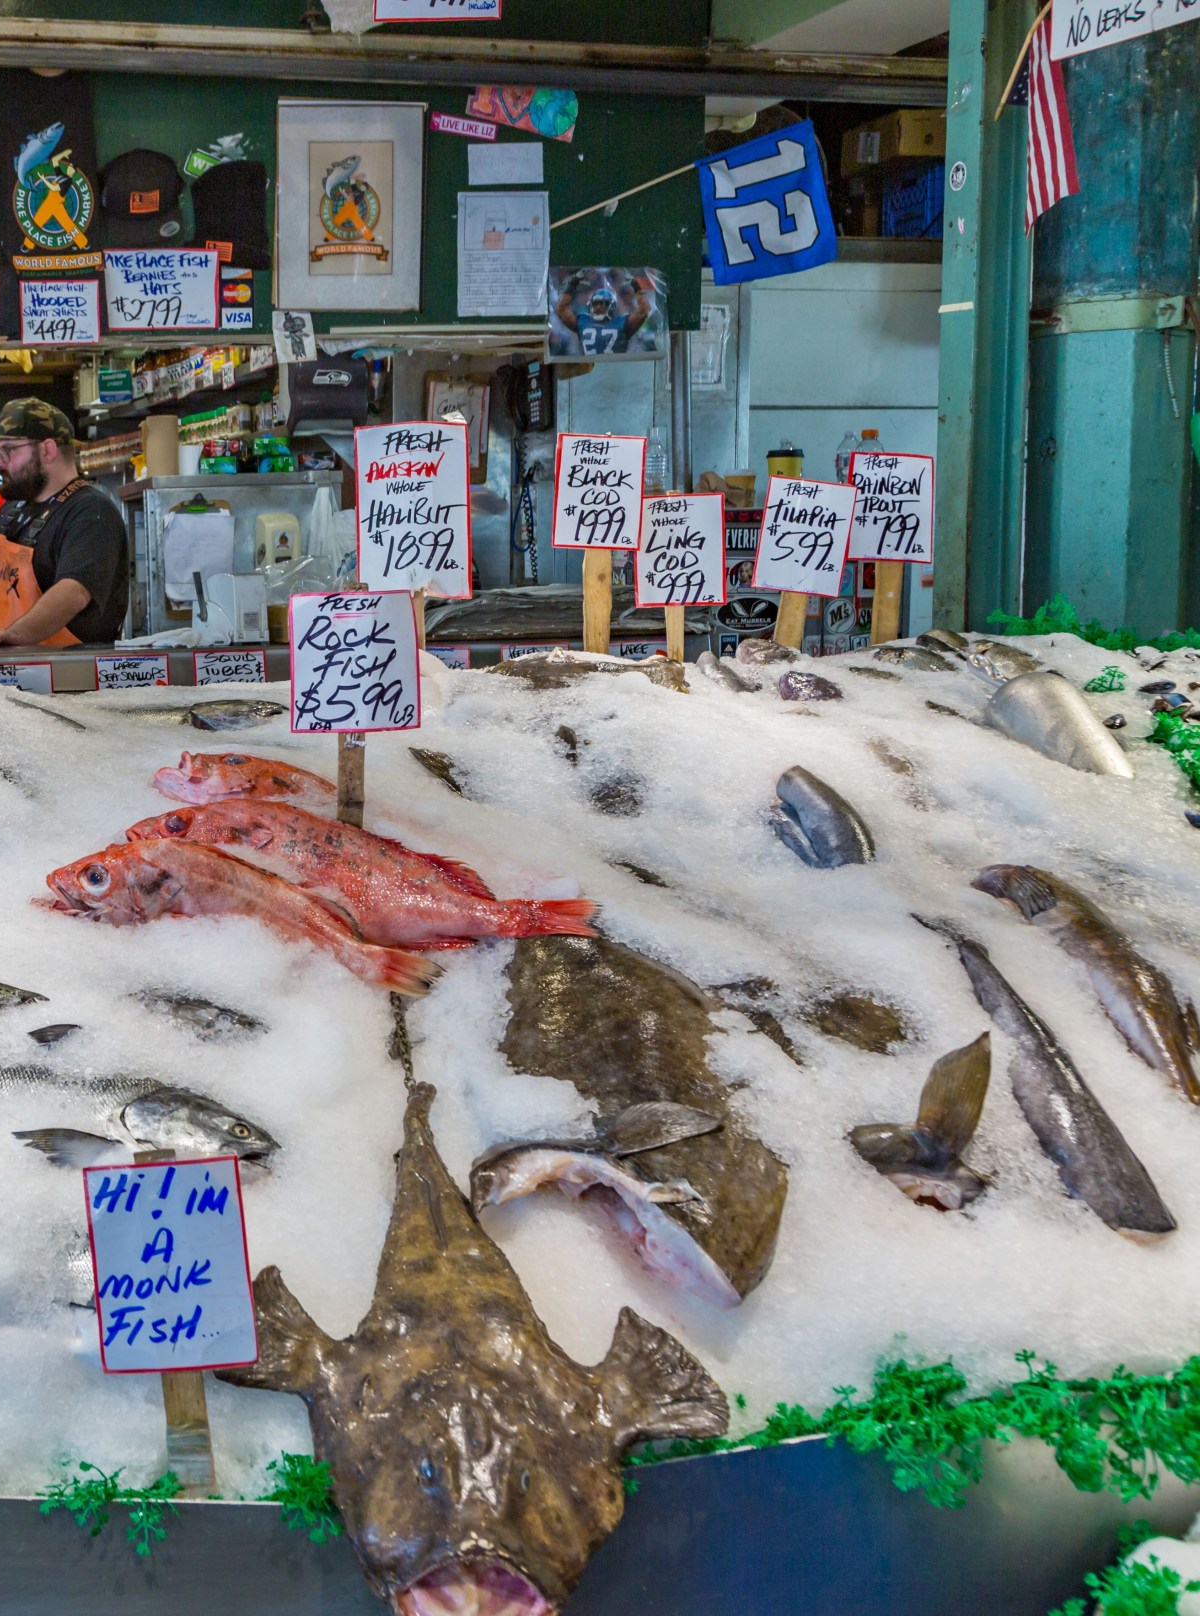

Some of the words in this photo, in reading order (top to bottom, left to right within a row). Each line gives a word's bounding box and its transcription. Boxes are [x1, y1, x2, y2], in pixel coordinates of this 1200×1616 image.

[1066, 7, 1091, 48] NO
[1097, 1, 1147, 37] LEAKS
[441, 118, 460, 131] LIVE
[461, 123, 479, 135] LIKE
[481, 125, 494, 138] LIZ
[709, 138, 820, 265] 12
[15, 189, 27, 217] PIKE
[22, 220, 54, 247] PLACE
[57, 227, 80, 246] FISH
[75, 177, 90, 228] MARKET
[15, 257, 52, 269] WORLD
[54, 254, 101, 267] FAMOUS
[103, 252, 133, 269] PIKE
[134, 252, 174, 269] PLACE
[177, 253, 212, 269] FISH
[121, 269, 176, 283] BEANIES
[139, 282, 183, 296] HATS
[31, 294, 87, 308] HOODED
[225, 311, 252, 323] VISA
[582, 328, 618, 355] 27
[383, 429, 453, 456] FRESH
[572, 439, 619, 456] FRESH
[365, 452, 445, 484] ALASKAN
[580, 456, 612, 466] WHOLE
[864, 455, 904, 470] FRESH
[568, 465, 634, 490] BLACK
[386, 480, 433, 496] WHOLE
[783, 482, 824, 499] FRESH
[581, 489, 621, 507] COD
[854, 496, 921, 513] TROUT
[361, 497, 468, 534] HALIBUT
[648, 500, 695, 516] FRESH
[766, 496, 847, 530] TILAPIA
[645, 526, 706, 553] LING
[855, 513, 920, 555] WHOLE
[369, 528, 455, 577] $18.99
[654, 551, 700, 573] COD
[318, 594, 383, 612] FRESH
[742, 617, 771, 625] MUSSELS
[829, 602, 850, 627] M's
[298, 615, 396, 651] ROCK
[113, 661, 143, 670] LARGE
[204, 652, 257, 664] SQUID
[313, 648, 397, 681] FISH
[98, 669, 121, 682] SEA
[198, 664, 254, 676] TUBES
[295, 679, 404, 730] $5.99
[309, 721, 333, 732] USA
[140, 1227, 175, 1264] A
[99, 1259, 213, 1299] MONK
